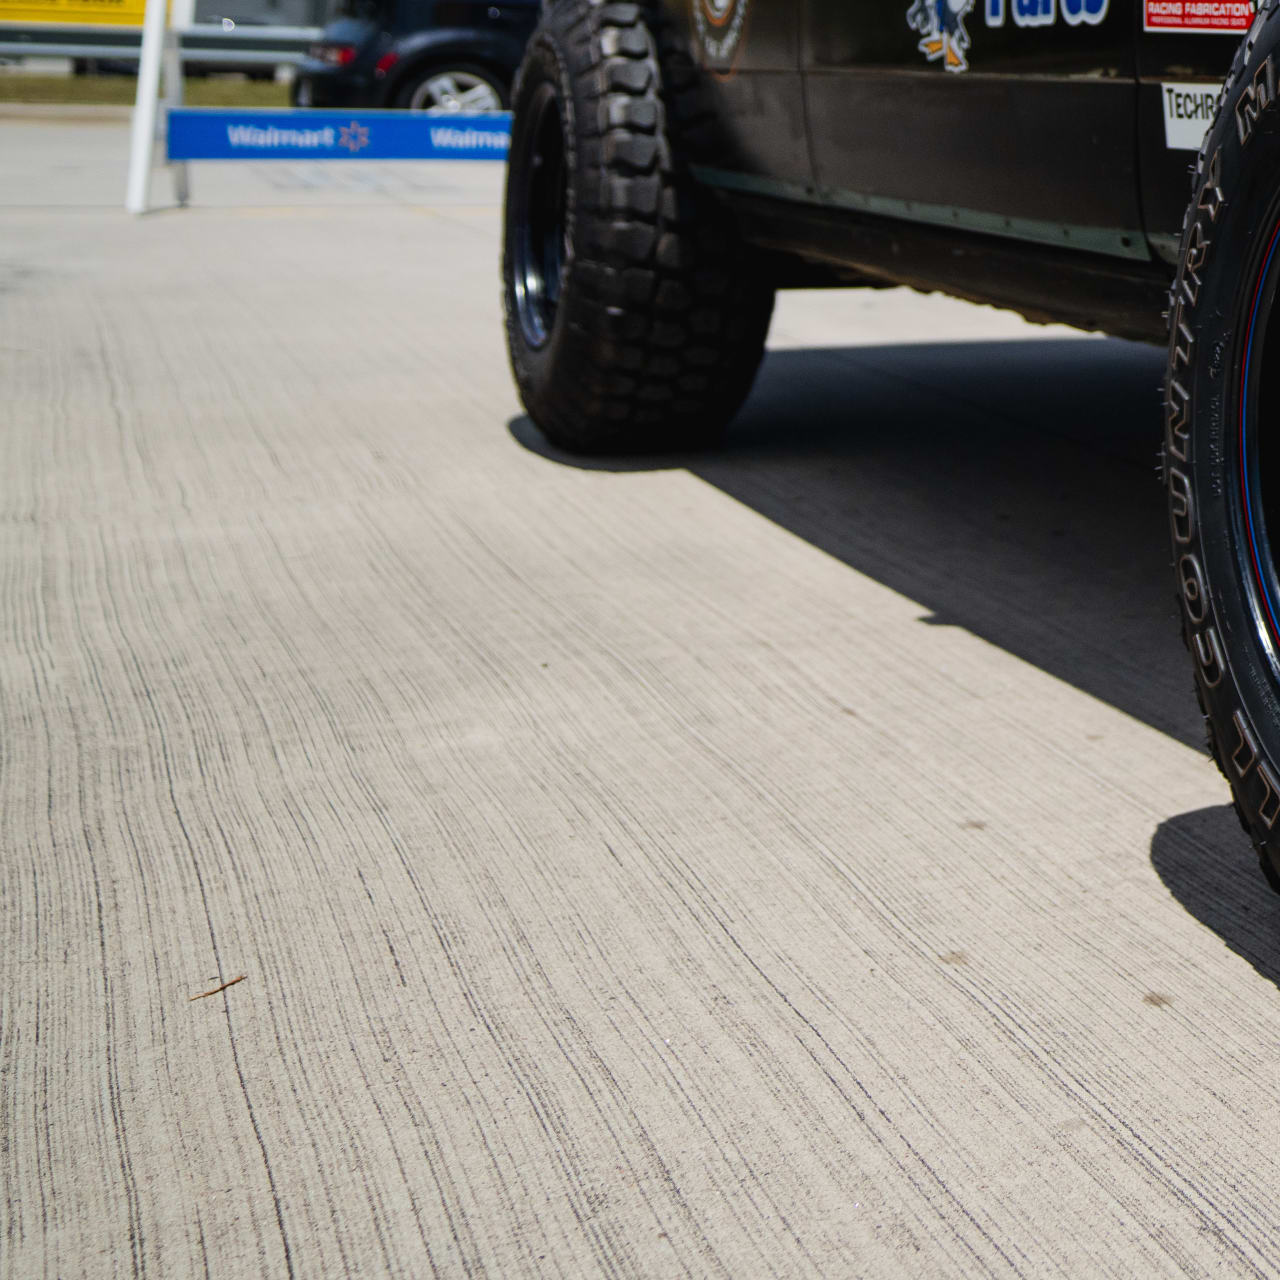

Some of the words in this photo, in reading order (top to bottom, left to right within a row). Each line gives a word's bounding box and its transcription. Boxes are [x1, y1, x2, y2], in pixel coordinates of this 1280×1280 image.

[1148, 2, 1182, 15] RACING
[1185, 2, 1249, 17] FABRICATION
[227, 124, 334, 147] Walmart
